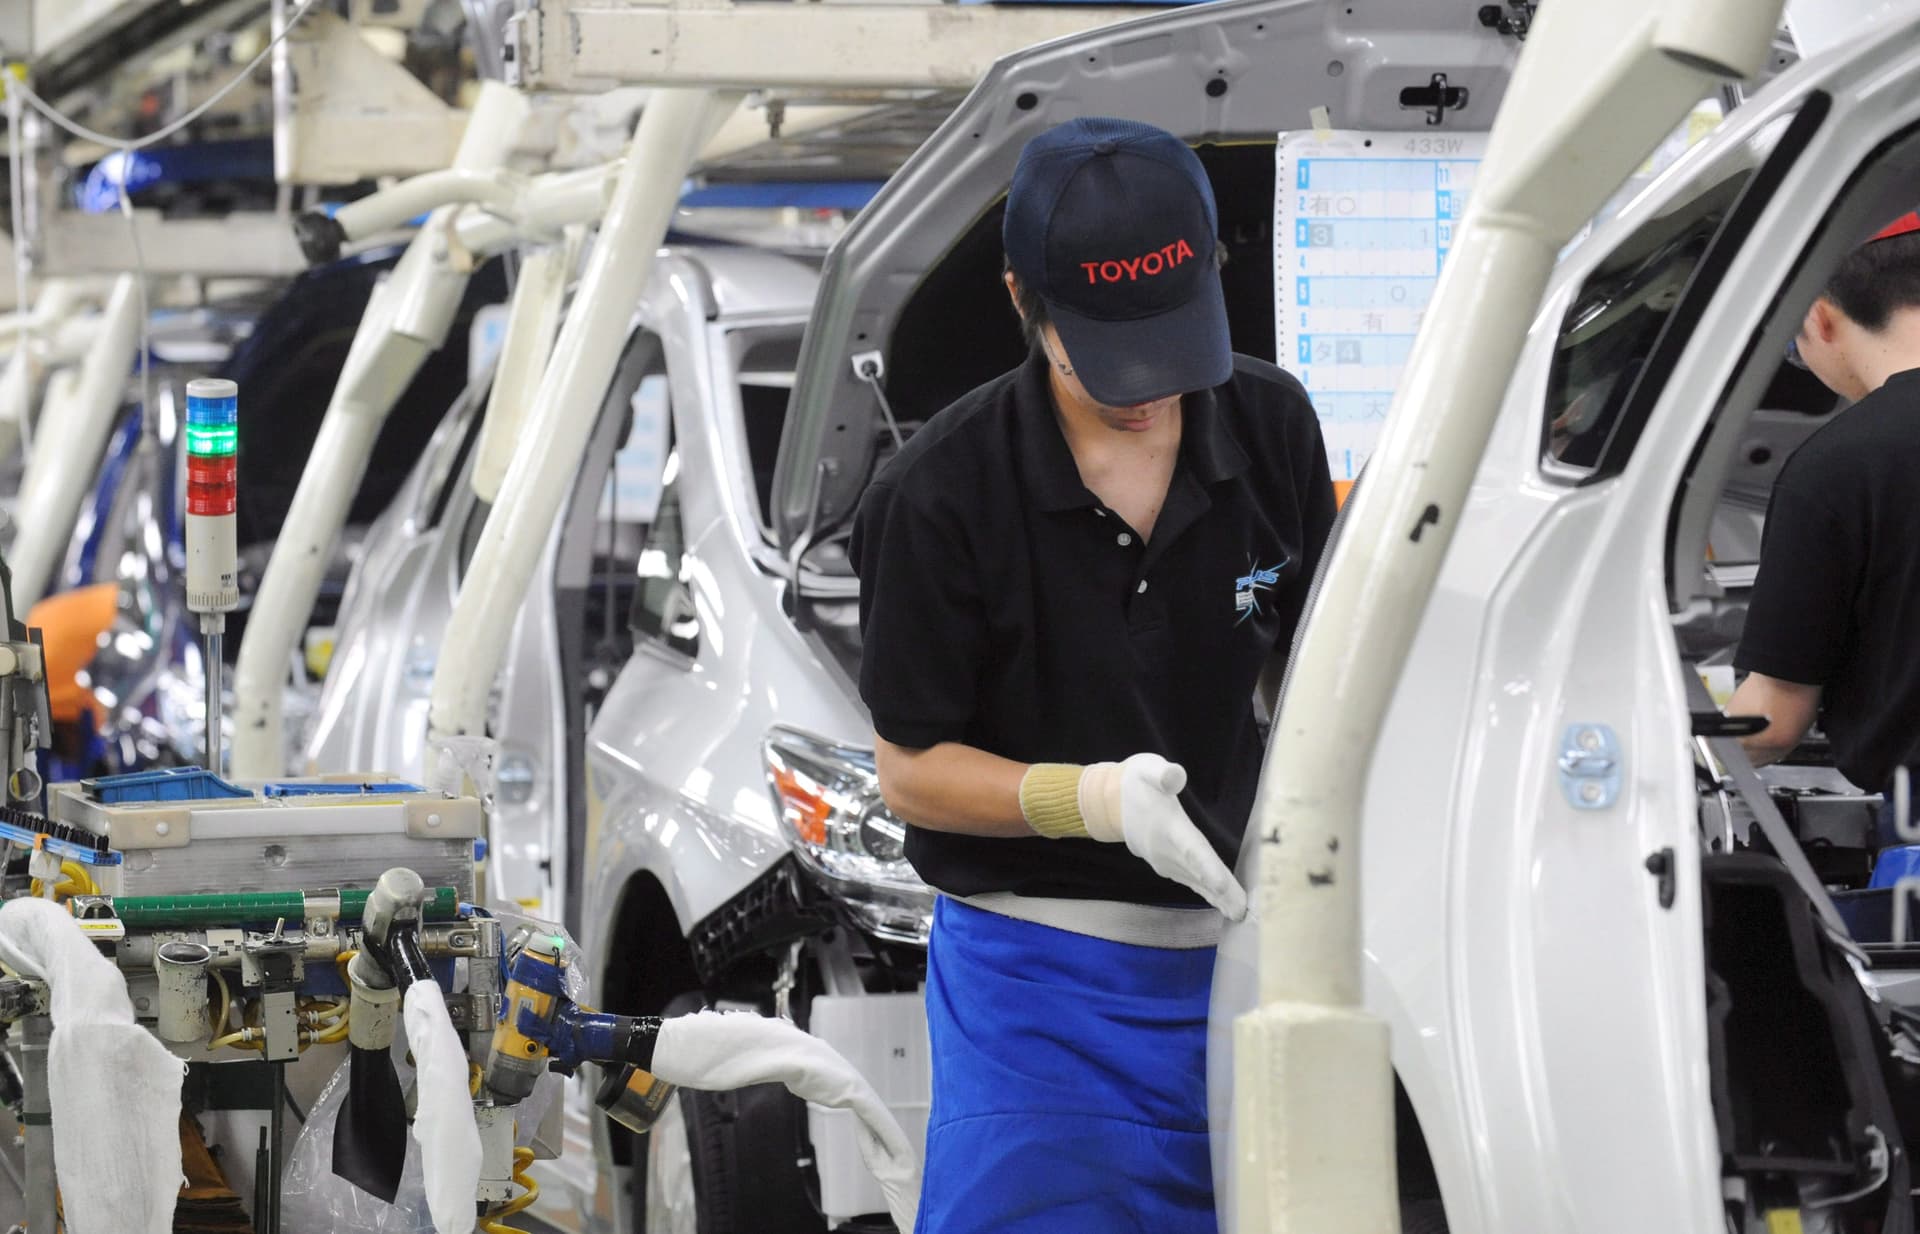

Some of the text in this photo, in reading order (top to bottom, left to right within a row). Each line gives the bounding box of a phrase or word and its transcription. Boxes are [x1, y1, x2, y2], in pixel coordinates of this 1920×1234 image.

[1404, 138, 1464, 154] 433W
[1439, 168, 1450, 182] 11
[1298, 196, 1306, 211] 2
[1439, 197, 1450, 211] 12
[1313, 226, 1328, 243] 3
[1080, 238, 1194, 285] TOYOTA
